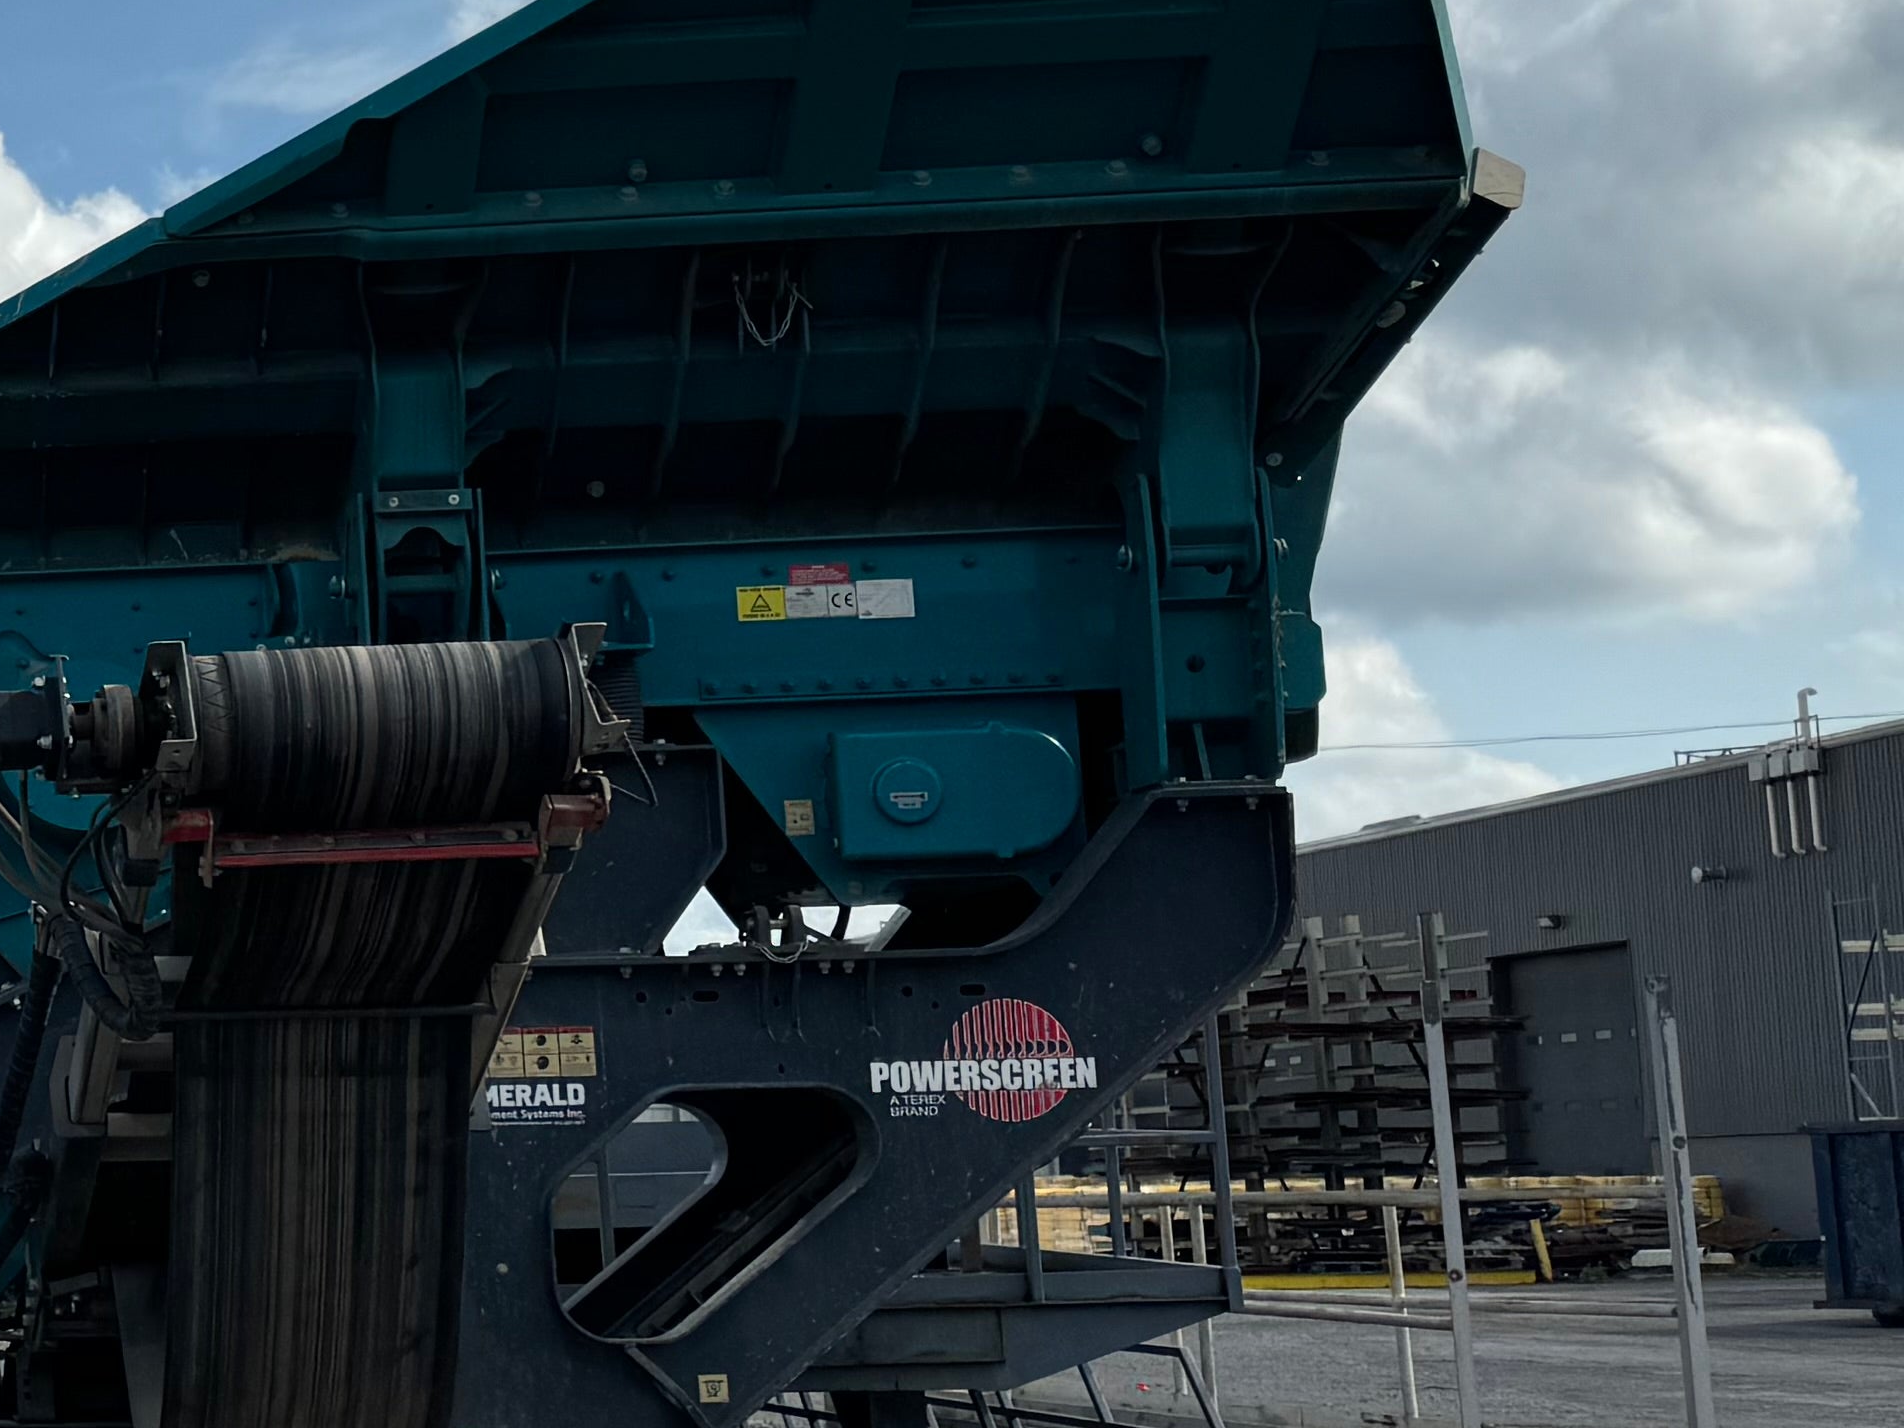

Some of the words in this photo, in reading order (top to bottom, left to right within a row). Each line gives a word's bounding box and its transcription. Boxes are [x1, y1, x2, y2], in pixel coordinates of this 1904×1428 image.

[870, 1057, 1097, 1093] POWERSCREEN
[486, 1083, 585, 1107] MERALD
[890, 1095, 900, 1105] A
[901, 1094, 946, 1105] TEREX
[521, 1109, 565, 1120] Systems
[890, 1105, 938, 1117] BRAND
